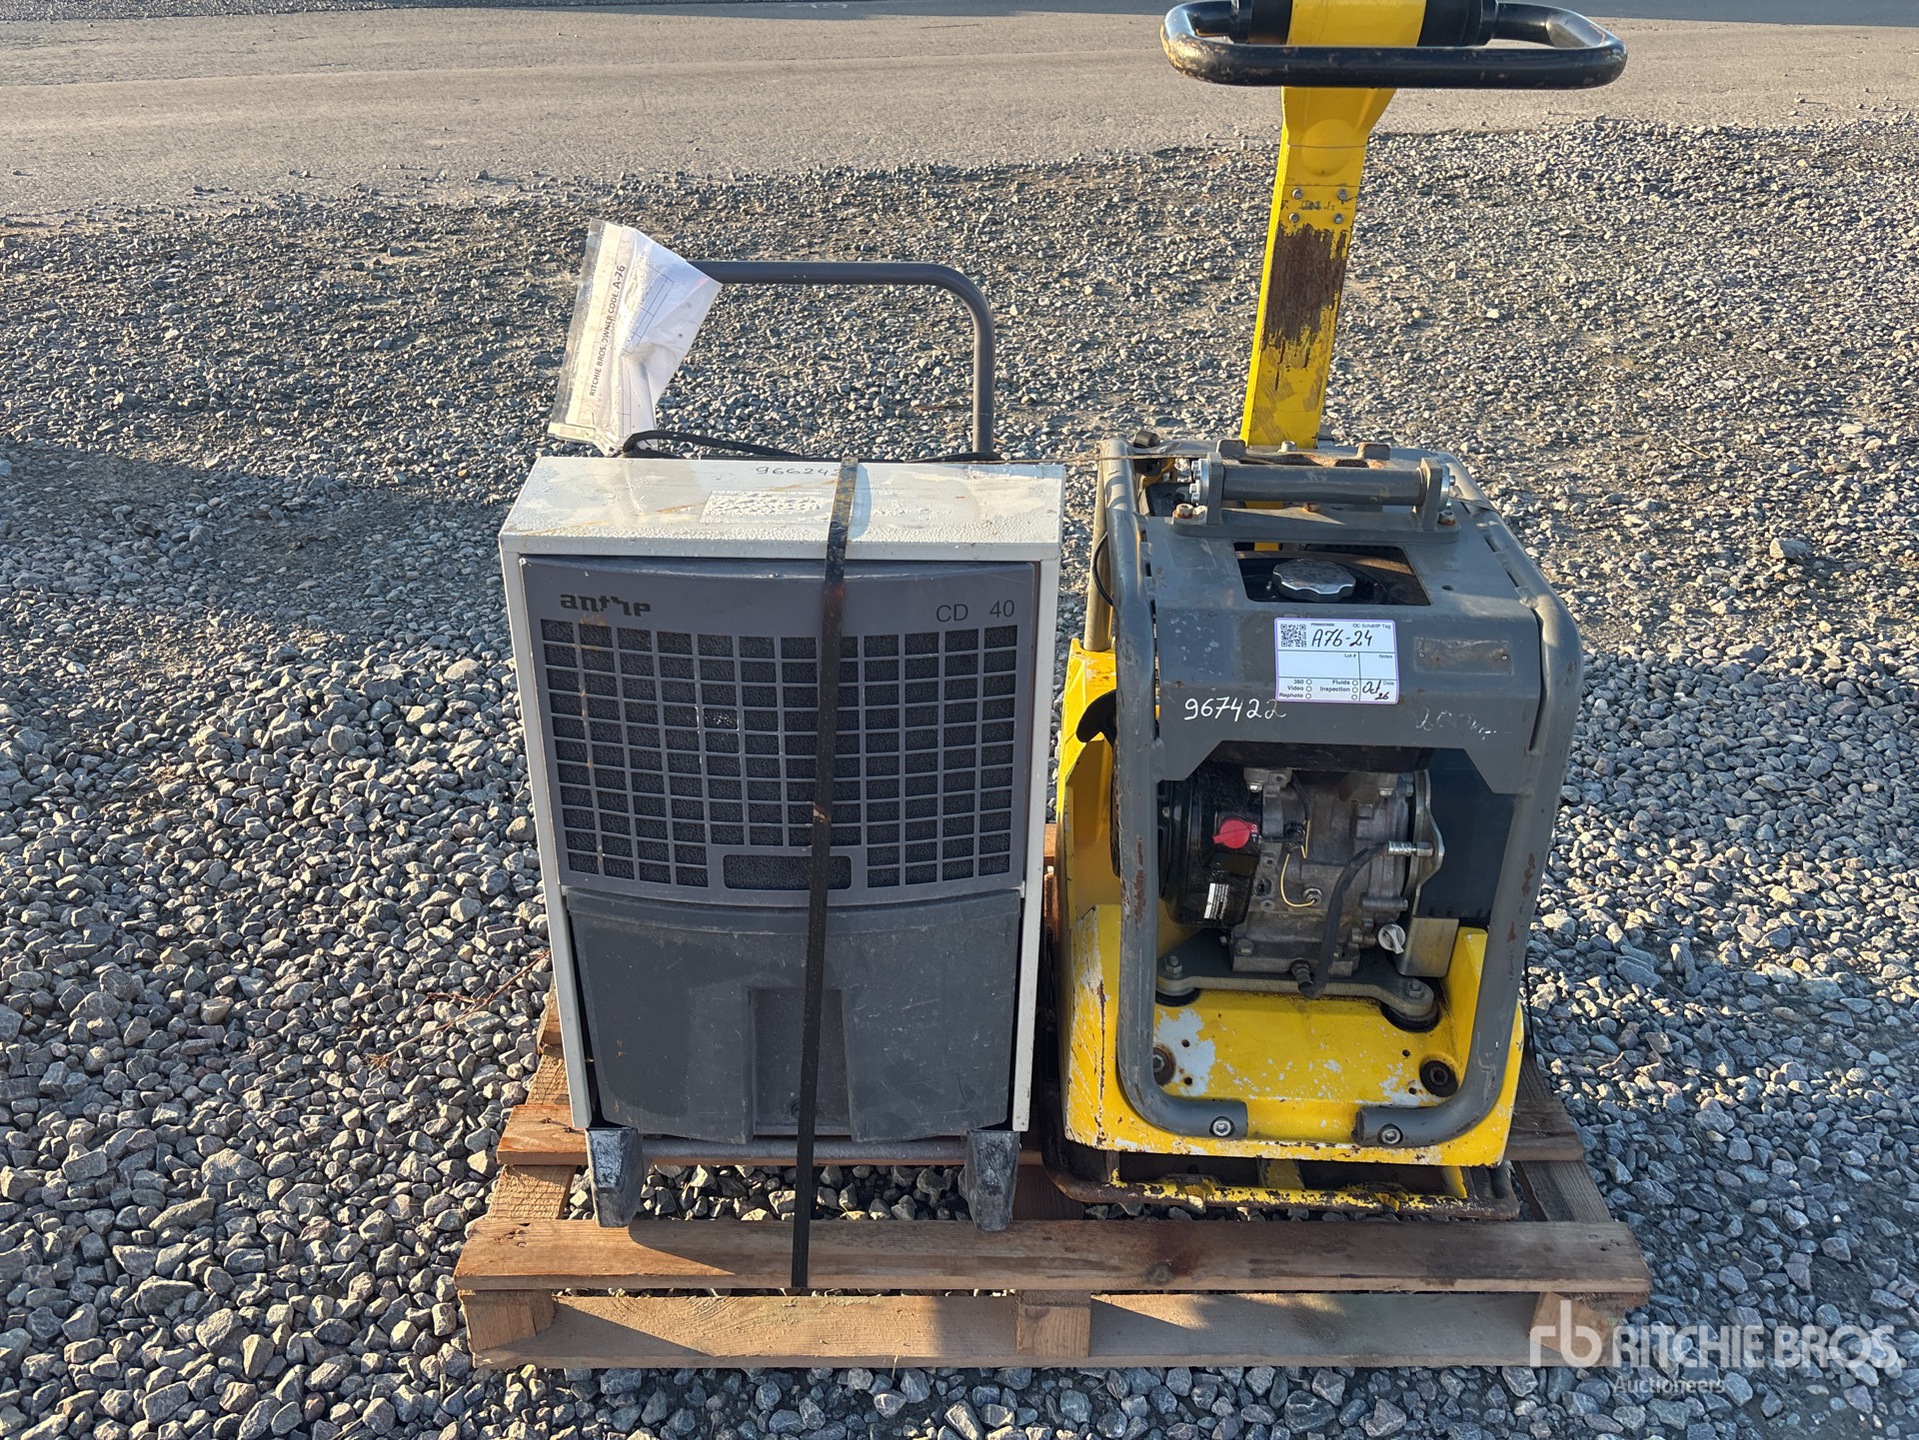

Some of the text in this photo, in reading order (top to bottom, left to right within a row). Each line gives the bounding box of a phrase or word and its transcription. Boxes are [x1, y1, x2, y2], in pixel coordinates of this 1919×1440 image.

[613, 265, 626, 289] A-76
[608, 291, 619, 314] CODE:
[597, 344, 607, 366] BROS.
[590, 367, 601, 396] RITCHIE
[936, 599, 1015, 623] CD 40
[1311, 628, 1373, 648] A76-24
[1184, 696, 1287, 722] 967422
